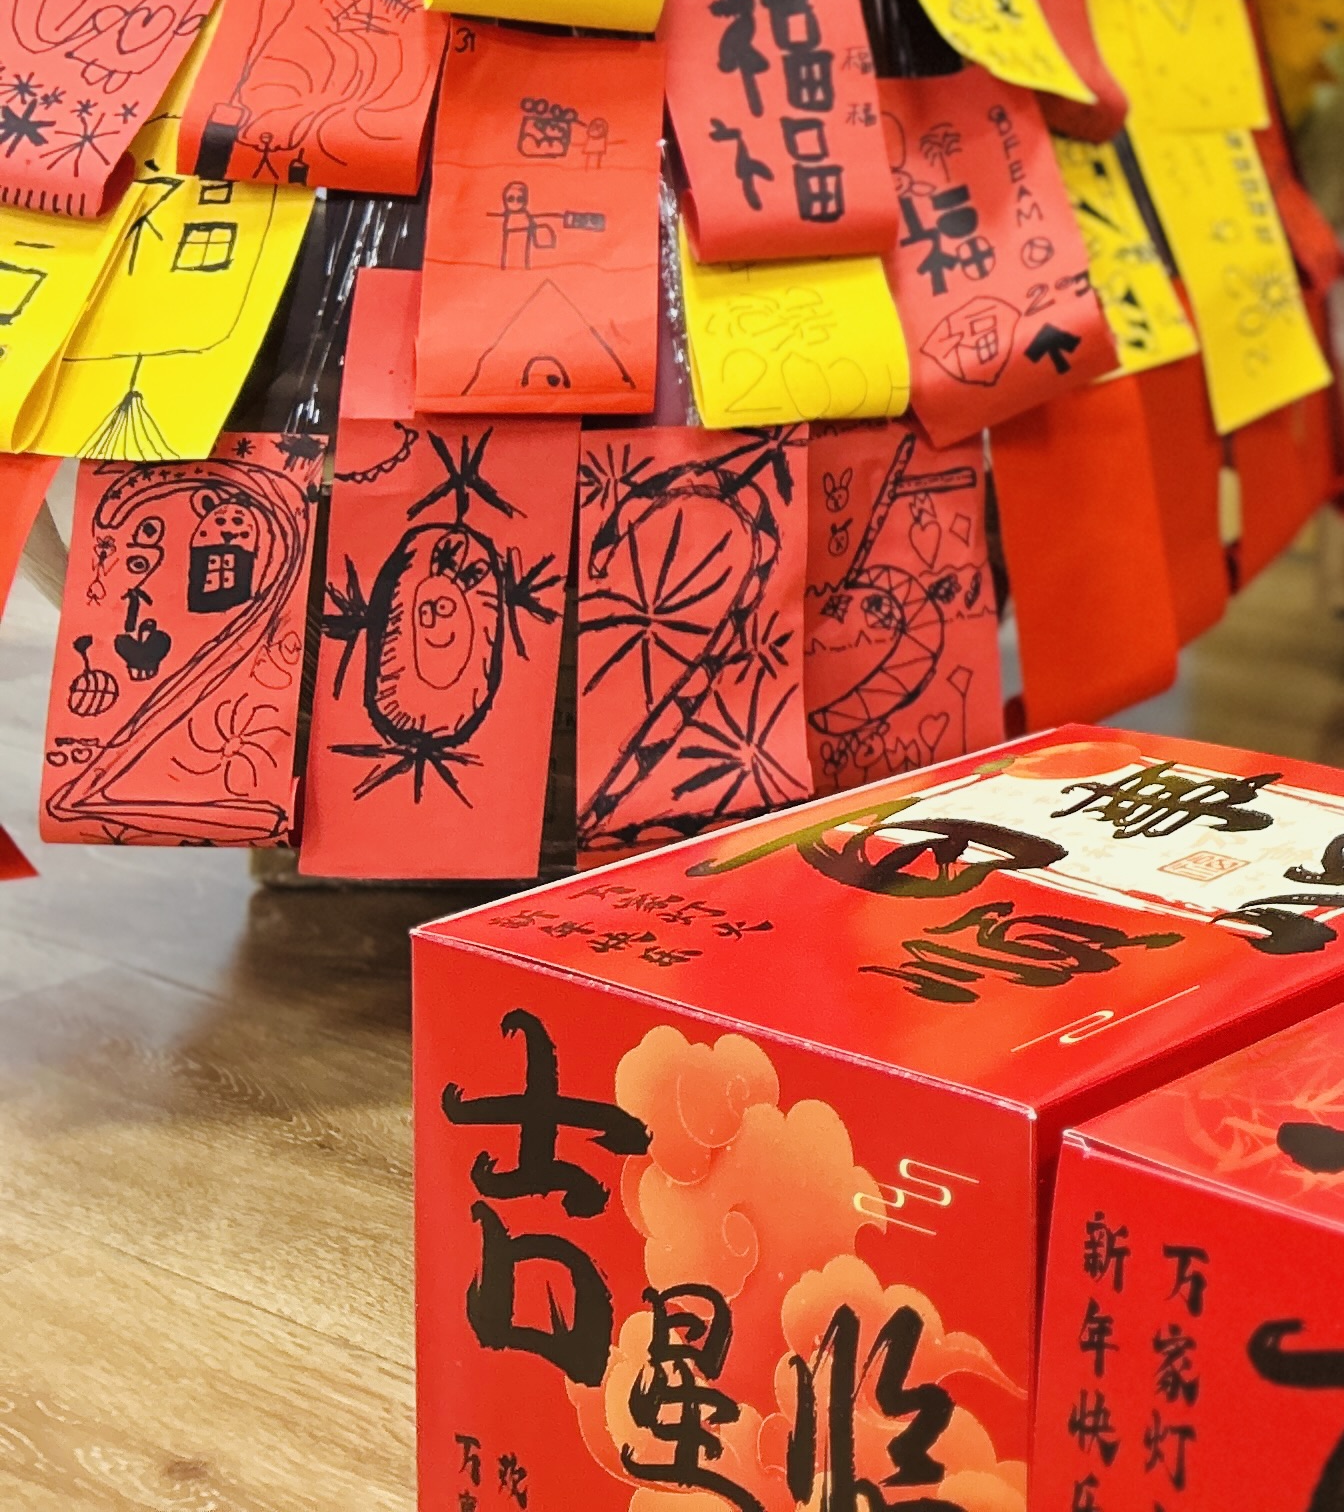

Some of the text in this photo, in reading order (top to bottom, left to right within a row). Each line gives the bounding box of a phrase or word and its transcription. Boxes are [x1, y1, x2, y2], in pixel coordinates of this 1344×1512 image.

[488, 908, 704, 968] 新年快乐
[567, 883, 773, 941] 万家灯火
[1142, 1244, 1210, 1512] 万家灯
